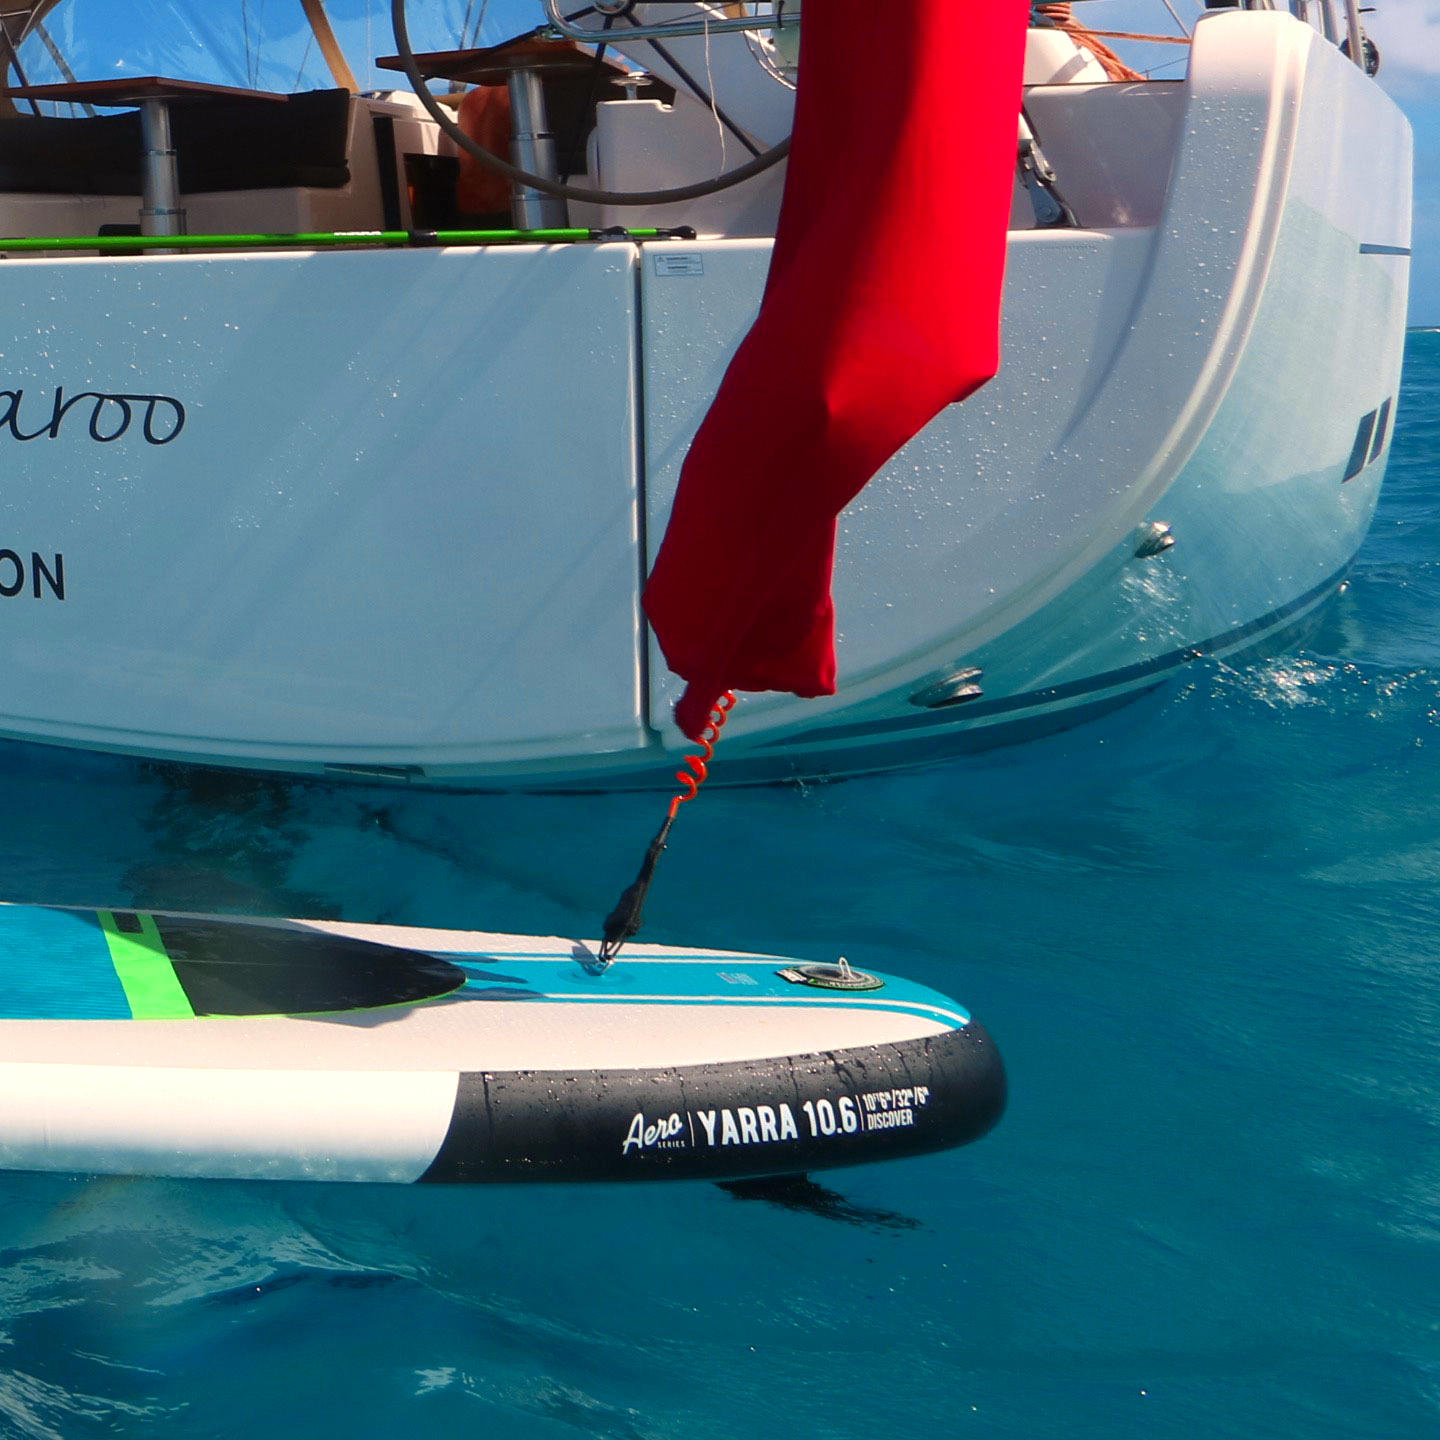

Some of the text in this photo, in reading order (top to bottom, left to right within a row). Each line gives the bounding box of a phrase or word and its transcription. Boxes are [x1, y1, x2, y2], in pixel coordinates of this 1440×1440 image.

[622, 1096, 858, 1155] Aero YARRA 10.6
[867, 1108, 914, 1130] DISCOVER
